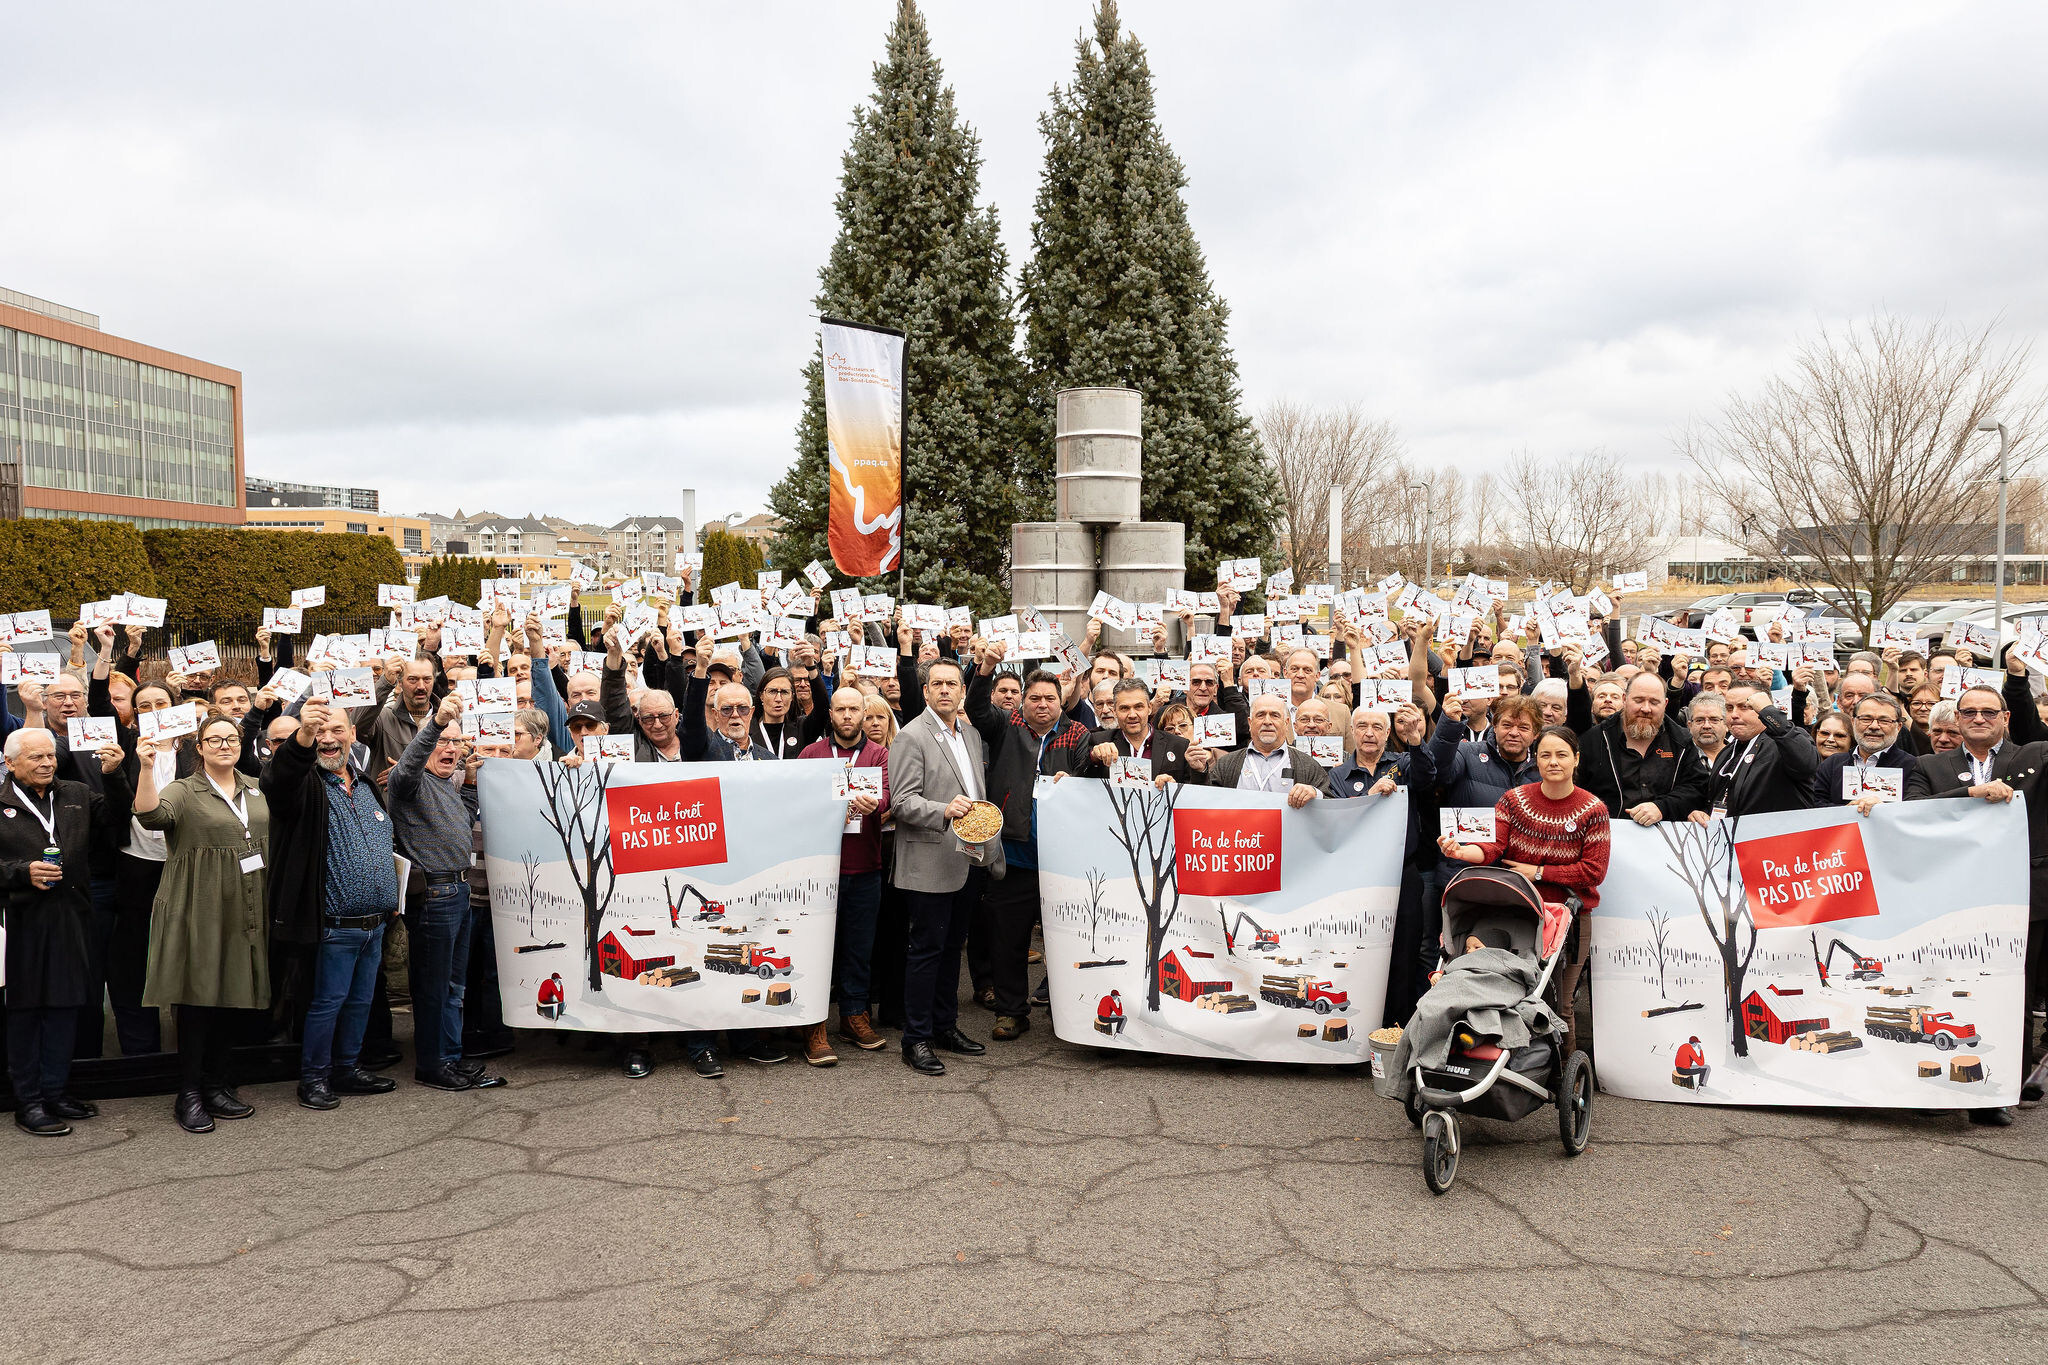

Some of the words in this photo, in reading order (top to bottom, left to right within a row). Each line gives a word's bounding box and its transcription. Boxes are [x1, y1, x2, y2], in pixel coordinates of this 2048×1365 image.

[854, 459, 888, 468] ppaq.ca
[1703, 565, 1758, 584] UQAR
[629, 806, 653, 826] Pas
[656, 804, 672, 822] de
[674, 801, 705, 820] forêt
[621, 829, 649, 850] PAS
[652, 827, 672, 847] DE
[675, 822, 718, 844] SIROP
[1192, 829, 1213, 849] Pas
[1216, 830, 1231, 849] de
[1234, 829, 1265, 849] forêt
[1185, 853, 1207, 872] PAS
[1211, 854, 1229, 872] DE
[1233, 853, 1275, 872] SIROP
[1762, 859, 1790, 880] Pas
[1793, 855, 1811, 875] de
[1812, 849, 1847, 872] forêt
[1758, 883, 1790, 907] PAS
[1791, 879, 1816, 901] DE
[1817, 871, 1864, 896] SIROP
